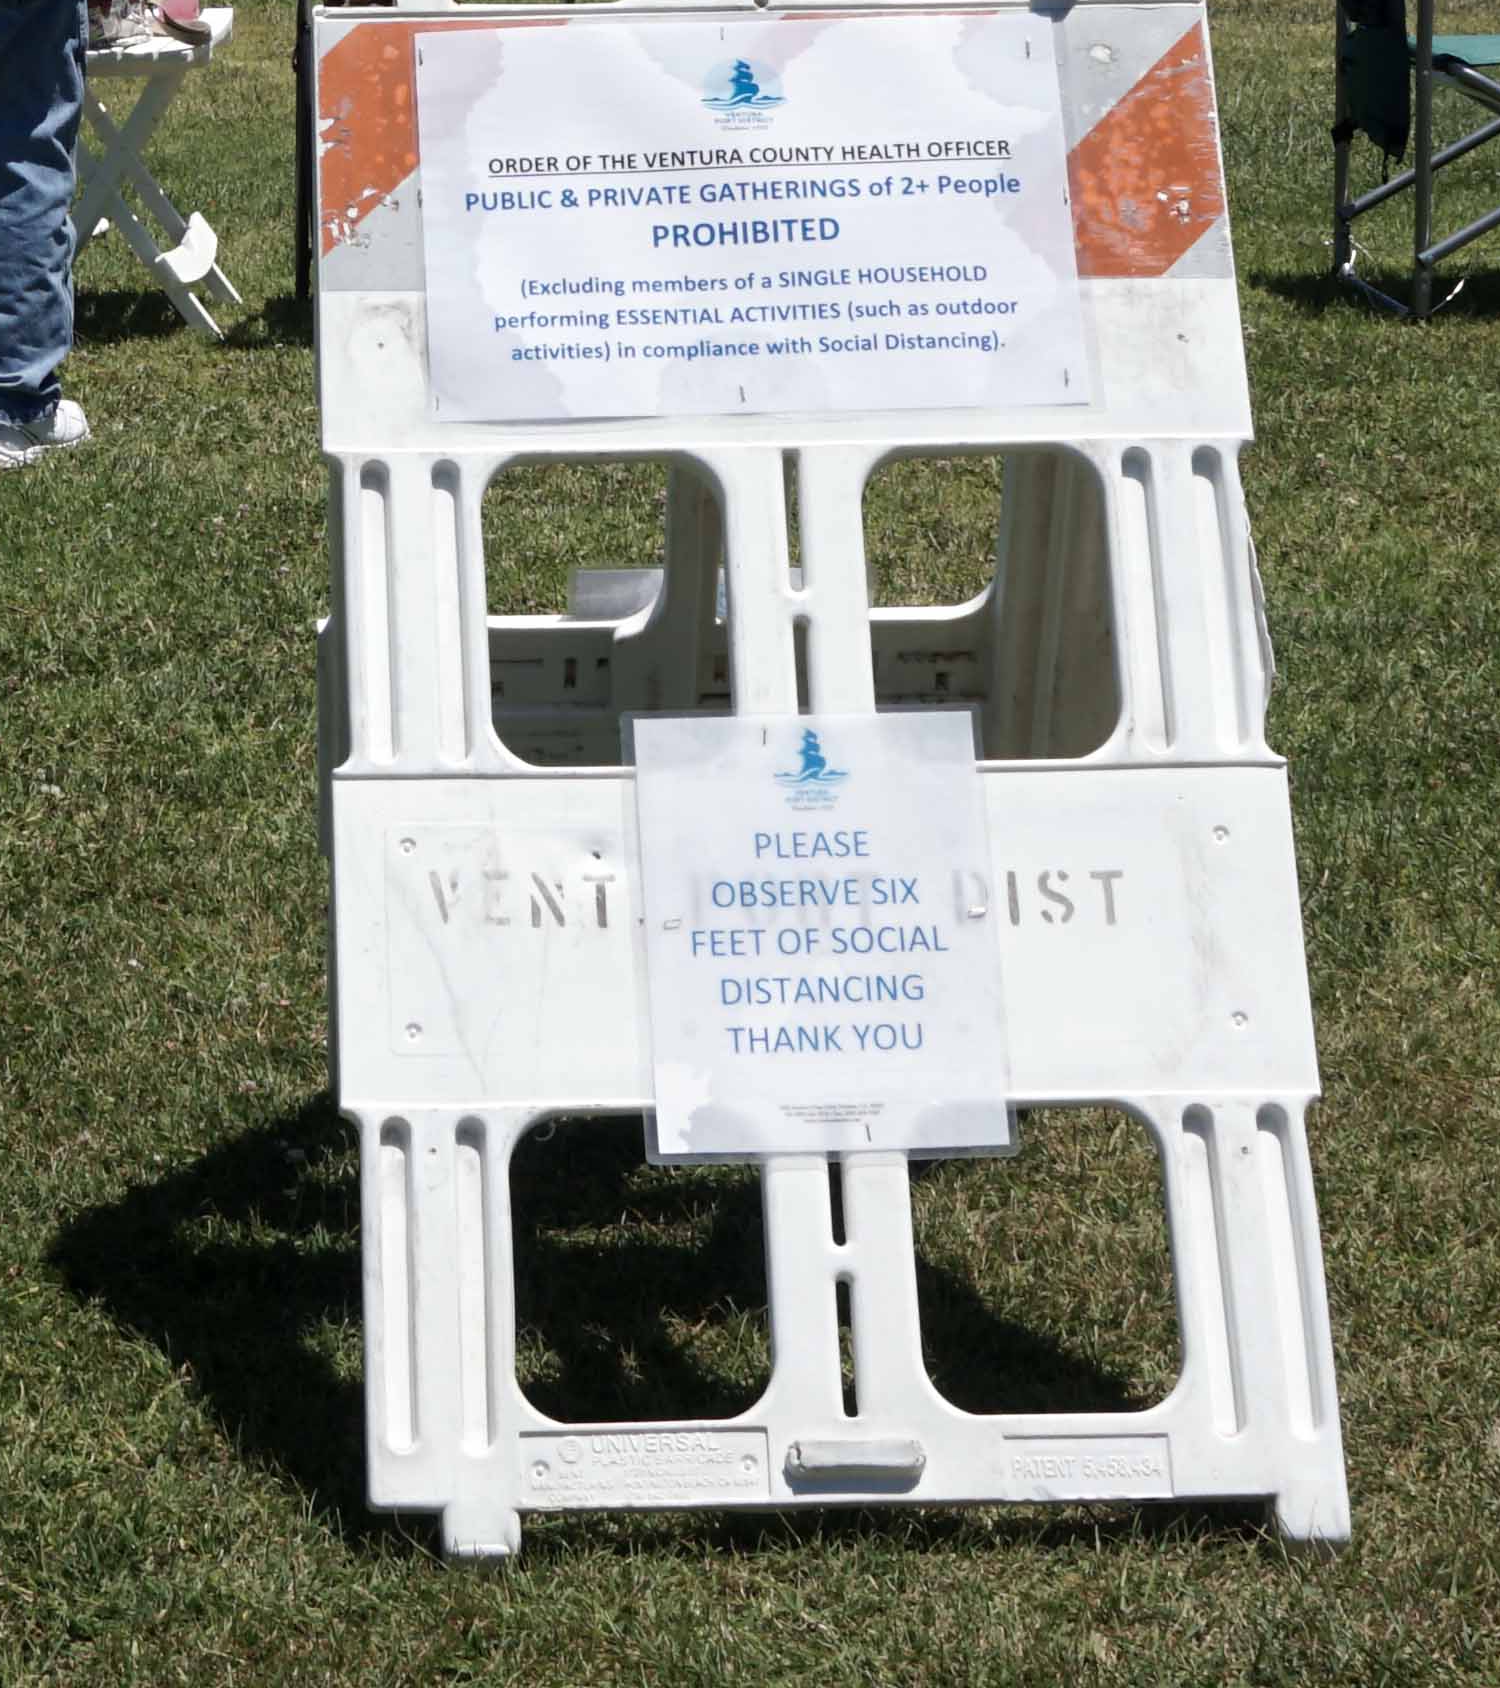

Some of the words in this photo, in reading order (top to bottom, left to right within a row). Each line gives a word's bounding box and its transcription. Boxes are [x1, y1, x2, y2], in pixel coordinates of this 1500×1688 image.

[488, 156, 559, 176] ORDER
[564, 155, 593, 173] OF
[597, 152, 638, 172] THE
[642, 149, 744, 171] VENTURA
[748, 146, 835, 166] COUNTY
[840, 142, 921, 162] HEALTH
[926, 139, 1012, 159] OFFICER
[465, 190, 553, 212] PUBLIC
[560, 188, 579, 208] &
[588, 185, 691, 207] PRIVATE
[699, 178, 861, 203] GATHERINGS
[868, 175, 893, 197] of
[901, 176, 929, 196] 2+
[937, 172, 1021, 198] People
[652, 217, 840, 248] PROHIBITED
[520, 276, 625, 299] (Excluding
[631, 275, 729, 293] members
[734, 272, 755, 290] of
[761, 276, 772, 289] a
[778, 268, 851, 288] SINGLE
[857, 265, 987, 284] HOUSEHOLD
[494, 310, 610, 333] performing
[616, 307, 724, 325] ESSENTIAL
[730, 302, 841, 323] ACTIVITIES
[847, 299, 901, 321] (such
[907, 303, 929, 317] as
[935, 297, 1018, 316] outdoor
[511, 341, 611, 362] activities)
[617, 341, 636, 359] in
[642, 339, 760, 361] compliance
[765, 336, 812, 355] with
[818, 333, 878, 353] Social
[885, 330, 1006, 352] Distancing).
[754, 830, 869, 859] PLEASE
[711, 878, 860, 908] OBSERVE
[871, 878, 920, 905] SIX
[691, 929, 766, 957] FEET
[777, 927, 819, 955] OF
[831, 925, 949, 955] SOCIAL
[720, 974, 924, 1006] DISTANCING
[726, 1025, 843, 1053] THANK
[852, 1023, 923, 1051] YOU
[591, 1434, 721, 1455] UNIVERSAL
[1011, 1456, 1077, 1480] PATENT
